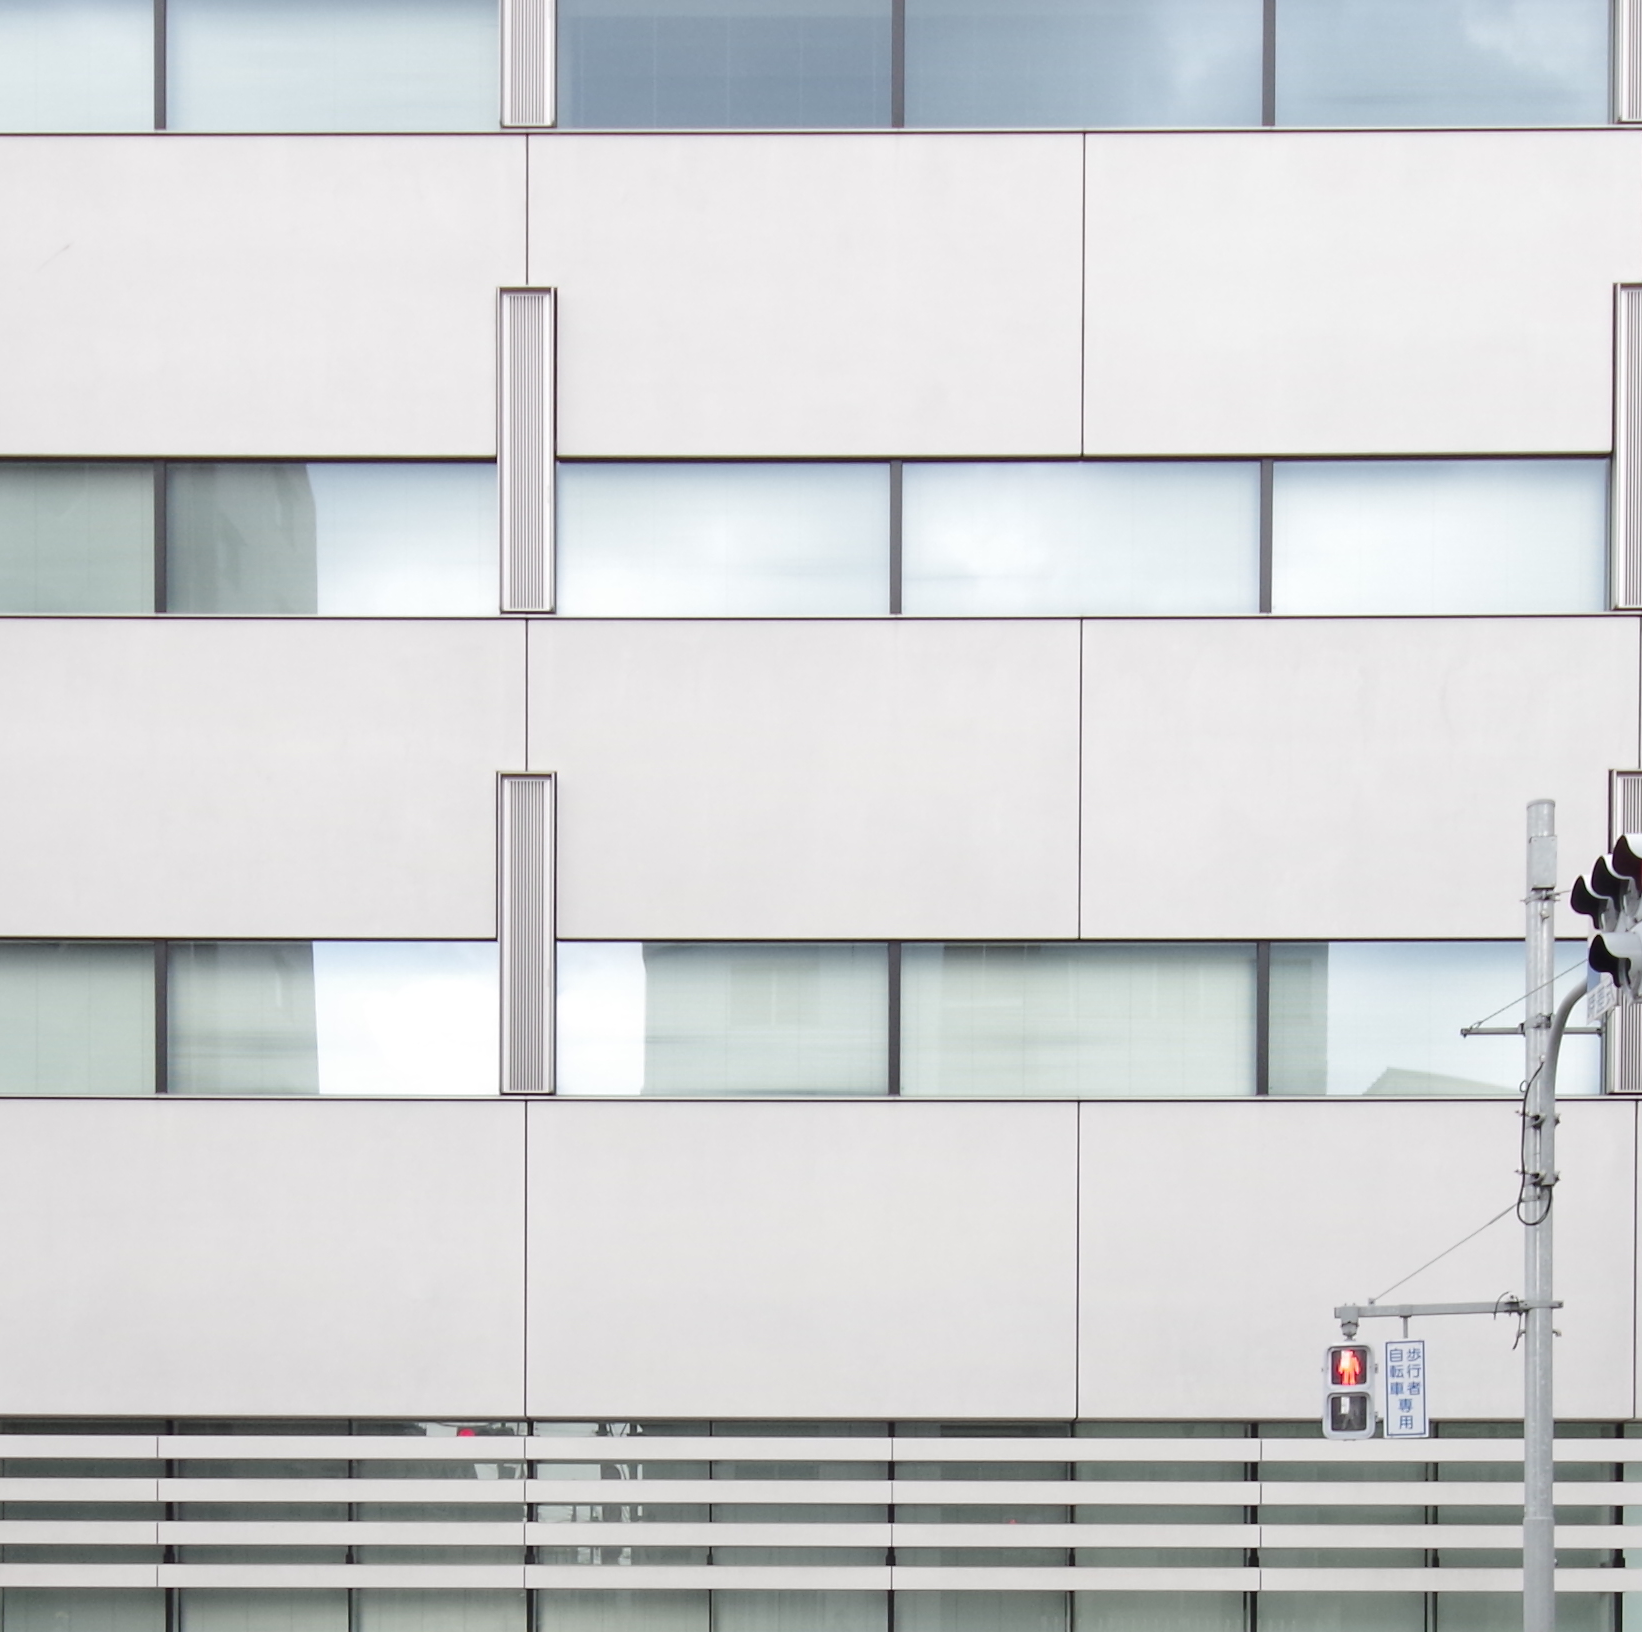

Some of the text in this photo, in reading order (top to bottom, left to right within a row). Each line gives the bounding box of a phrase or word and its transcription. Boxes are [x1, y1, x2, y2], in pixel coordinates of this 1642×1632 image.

[1390, 1347, 1404, 1396] 自転車
[1407, 1347, 1421, 1395] 歩行者
[1398, 1398, 1413, 1429] 専用
